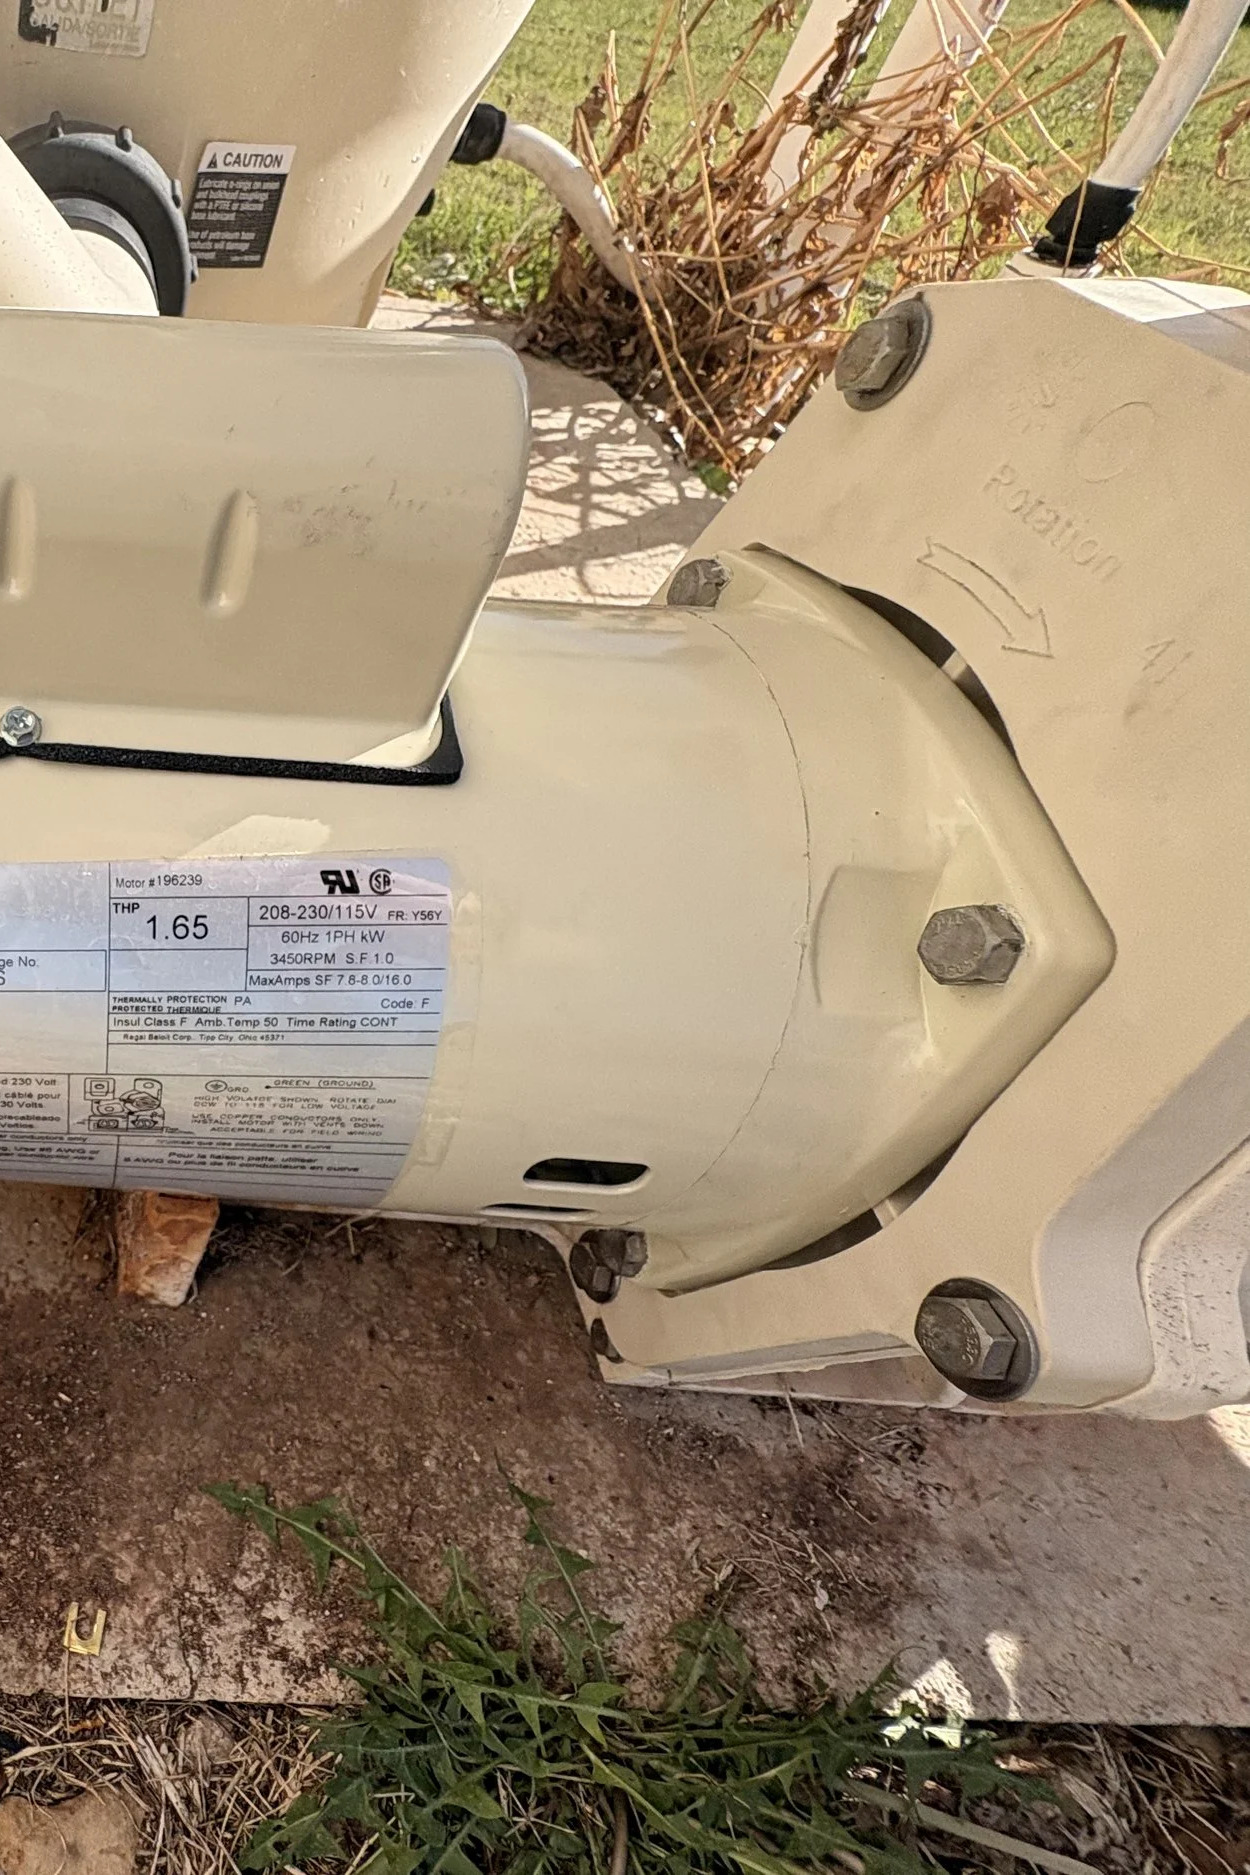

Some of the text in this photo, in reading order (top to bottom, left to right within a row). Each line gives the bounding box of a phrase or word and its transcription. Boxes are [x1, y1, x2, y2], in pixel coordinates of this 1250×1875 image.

[223, 152, 283, 169] CAUTION
[983, 463, 1123, 582] Rotation
[115, 874, 203, 889] Motor #196239
[113, 903, 140, 914] THP
[259, 904, 378, 920] 208-230/115V
[412, 910, 443, 921] Y56Y
[146, 914, 209, 940] 1.65
[281, 930, 386, 943] 60Hz 1PH kW
[18, 956, 40, 968] No.
[270, 953, 336, 965] 3450RPM
[249, 974, 412, 988] MaxAmps SF 7.8-8.0/16.0
[112, 995, 252, 1006] THERMALLY PROTECTION PA
[380, 997, 431, 1009] Code: F
[112, 1005, 223, 1014] PROTECTED THERMIQUE
[113, 1017, 141, 1027] Insul
[144, 1017, 176, 1027] Class
[180, 1017, 188, 1026] F
[263, 1017, 278, 1027] 50
[287, 1017, 315, 1027] Time
[320, 1017, 357, 1029] Rating
[360, 1017, 399, 1027] CONT
[123, 1033, 147, 1042] Regal
[148, 1033, 170, 1041] Beloit
[199, 1033, 216, 1042] Tipp
[237, 1033, 257, 1041] Ohio
[12, 1077, 32, 1086] 230
[318, 1080, 374, 1088] (GROUND)
[37, 1093, 61, 1101] pour
[270, 1114, 343, 1122] CONDUCTORS
[10, 1133, 64, 1141] conductors
